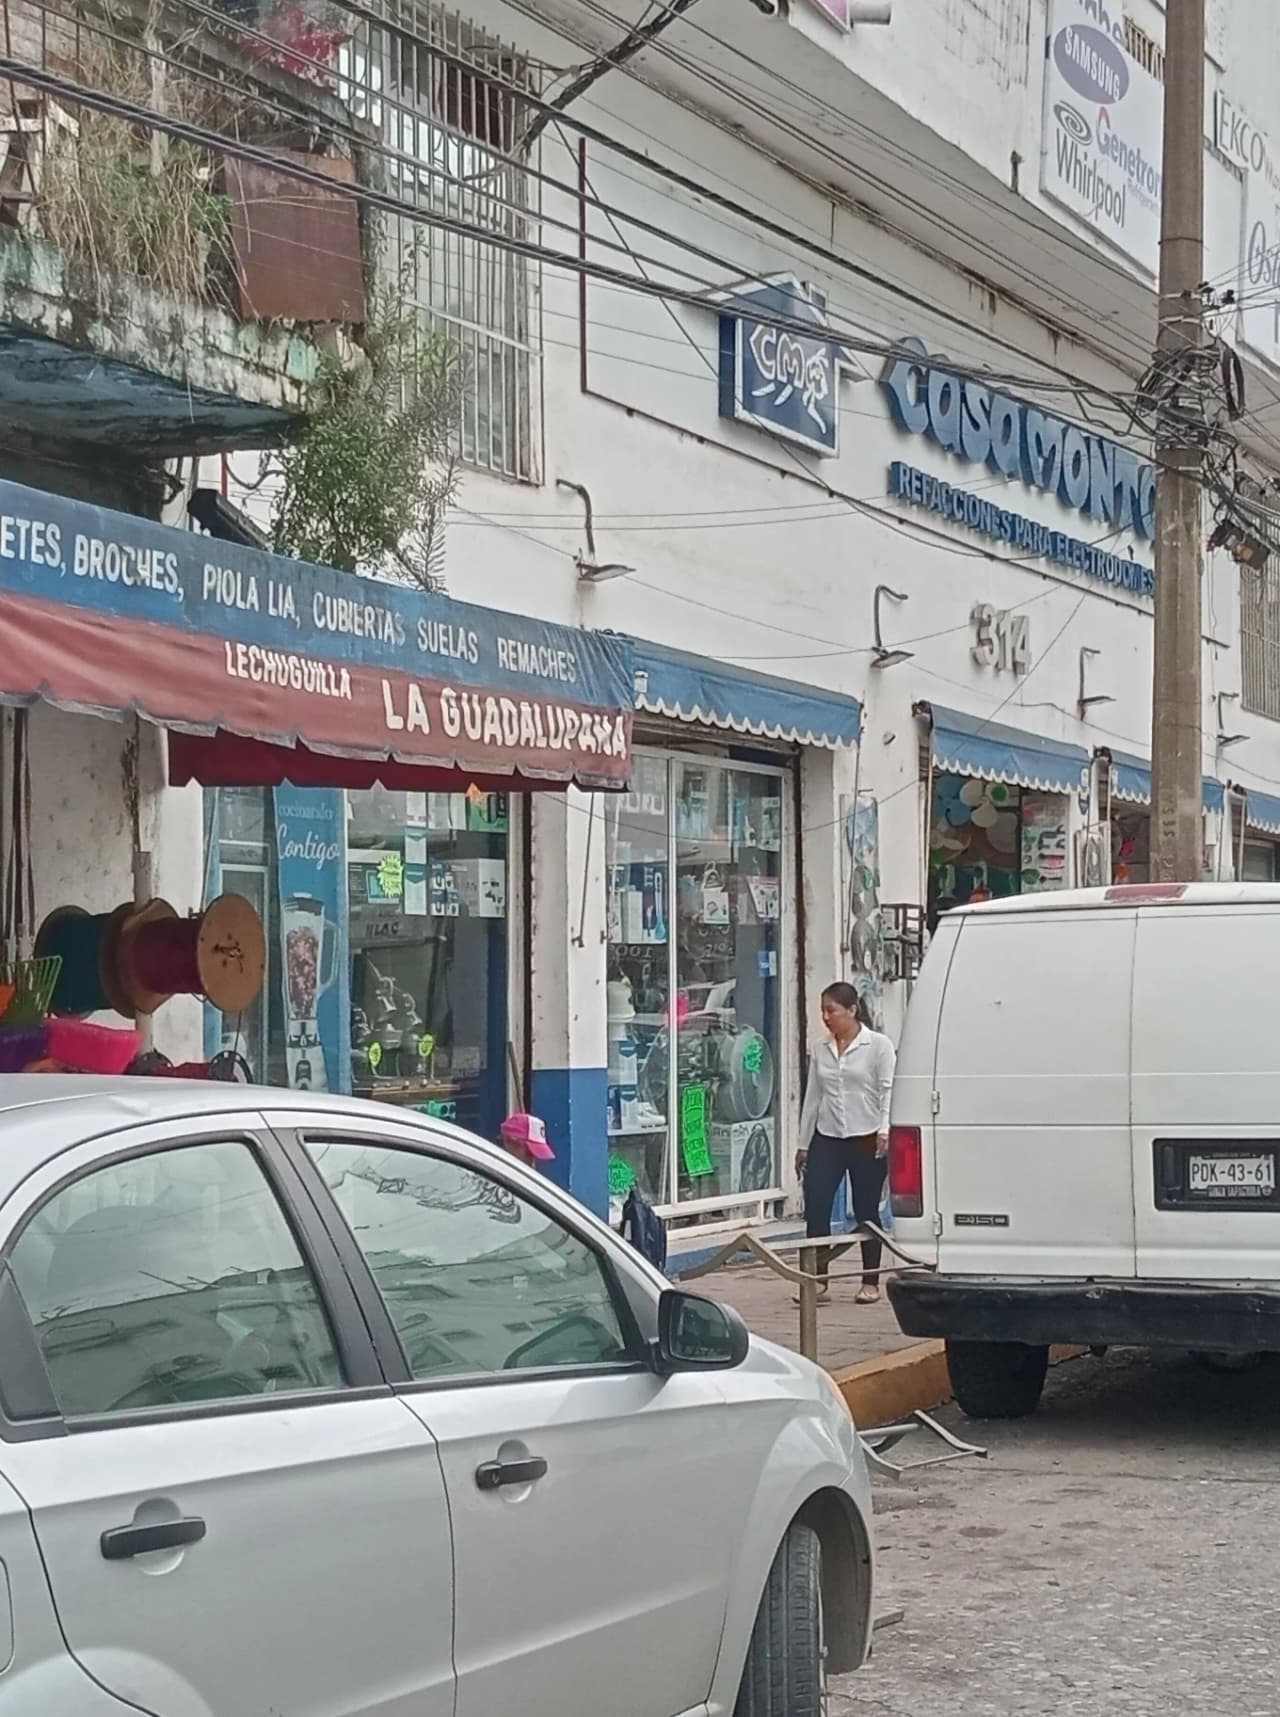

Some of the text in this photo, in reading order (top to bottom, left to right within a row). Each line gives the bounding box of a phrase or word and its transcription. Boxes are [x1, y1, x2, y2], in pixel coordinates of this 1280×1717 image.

[1065, 26, 1120, 101] SAMSUNG
[1219, 94, 1265, 173] EKCO
[1056, 128, 1126, 228] Whirlpool
[894, 462, 1011, 540] REFACCIONES
[1015, 514, 1053, 556] PARA
[74, 534, 184, 603] BROCHES,
[203, 563, 259, 612] PIOLA
[268, 580, 301, 630] LIA,
[313, 591, 406, 646] CUBIERTAS
[418, 618, 479, 664] SUELAS
[497, 636, 577, 683] REMACHES
[225, 640, 627, 760] LECHUGUILLA LA GUADALUPANA
[277, 823, 340, 871] Contigo
[1192, 1163, 1271, 1182] PDK-43-61
